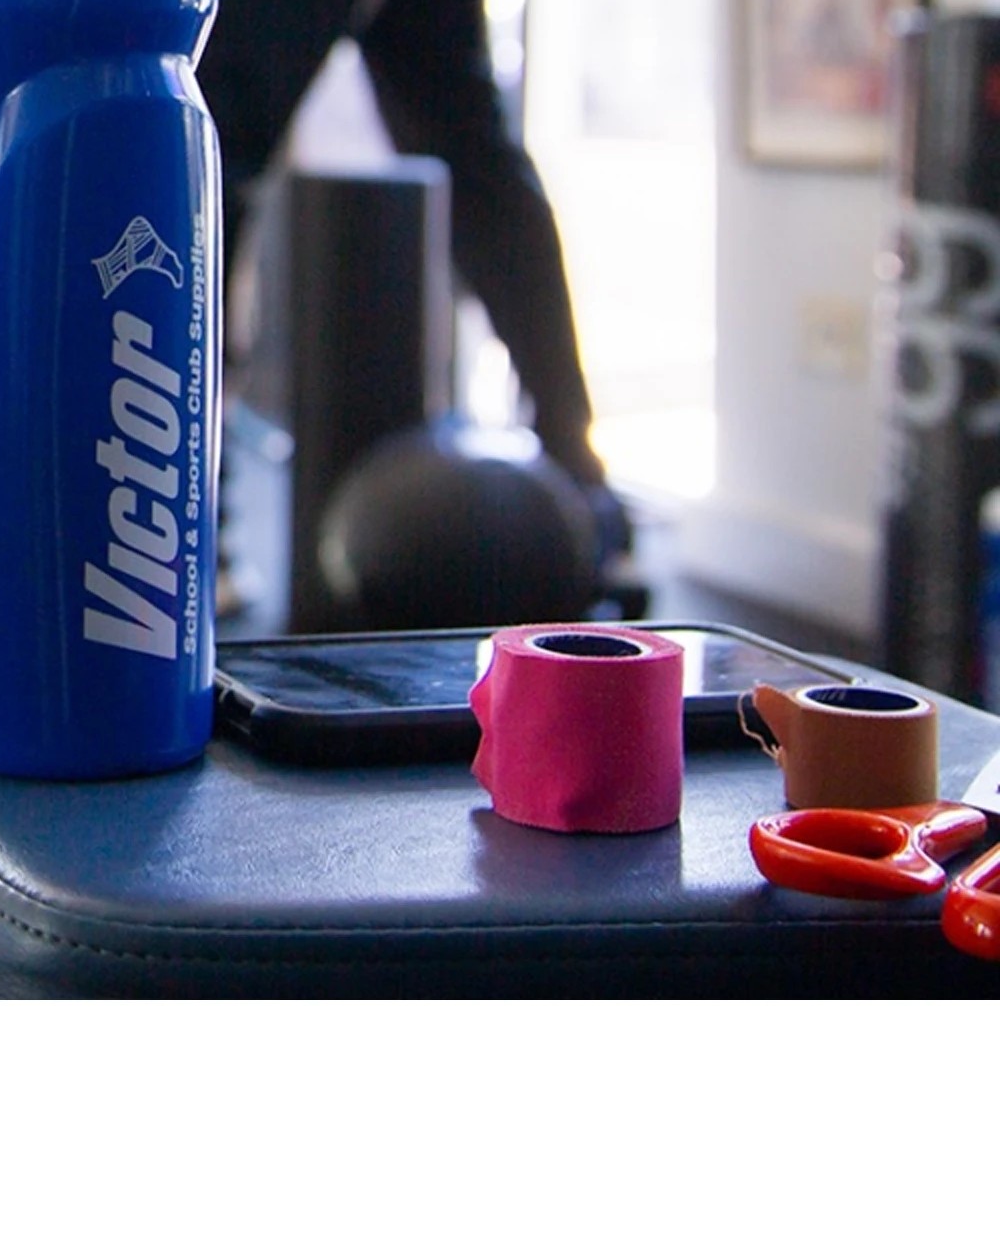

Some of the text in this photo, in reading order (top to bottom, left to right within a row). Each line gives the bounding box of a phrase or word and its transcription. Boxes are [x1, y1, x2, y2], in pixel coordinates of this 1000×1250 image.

[83, 310, 182, 661] Victor
[183, 213, 206, 654] School & Sports Club Supplies
